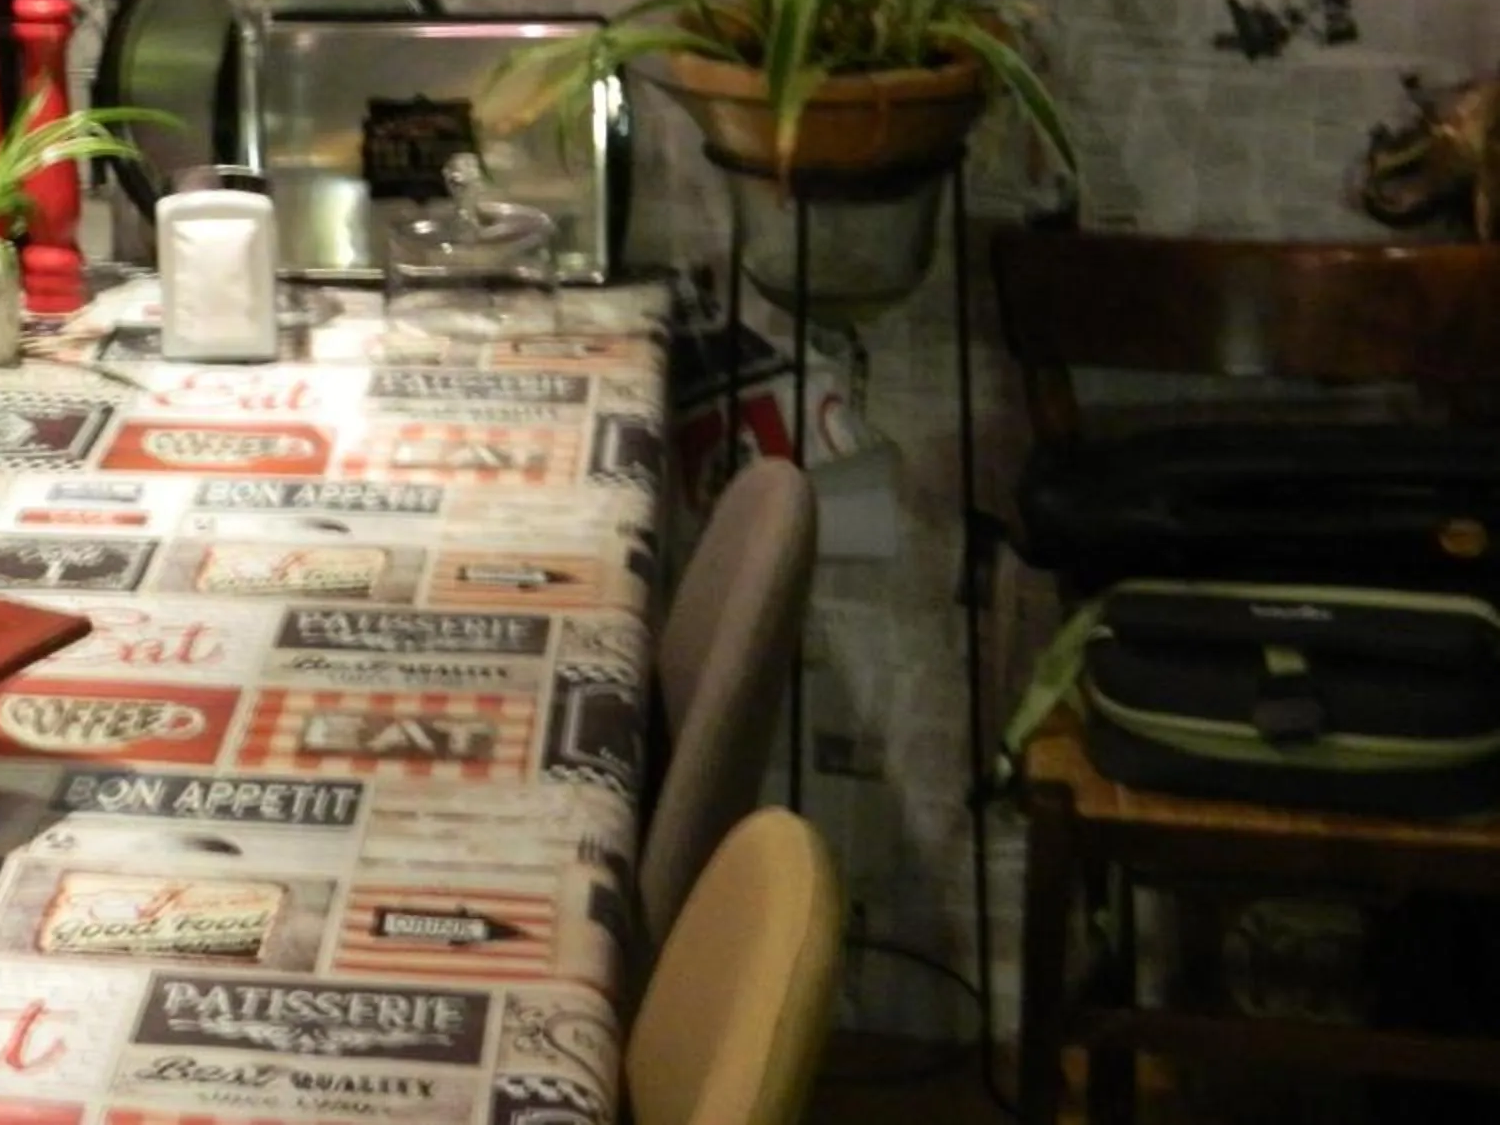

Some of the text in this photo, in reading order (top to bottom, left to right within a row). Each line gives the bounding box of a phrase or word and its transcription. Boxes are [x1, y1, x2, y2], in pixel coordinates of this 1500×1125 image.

[206, 481, 278, 508] BON
[10, 697, 168, 743] COFFEE
[305, 712, 495, 757] EAT
[66, 774, 358, 826] BON APPETIT
[161, 979, 466, 1033] PATISSERIE
